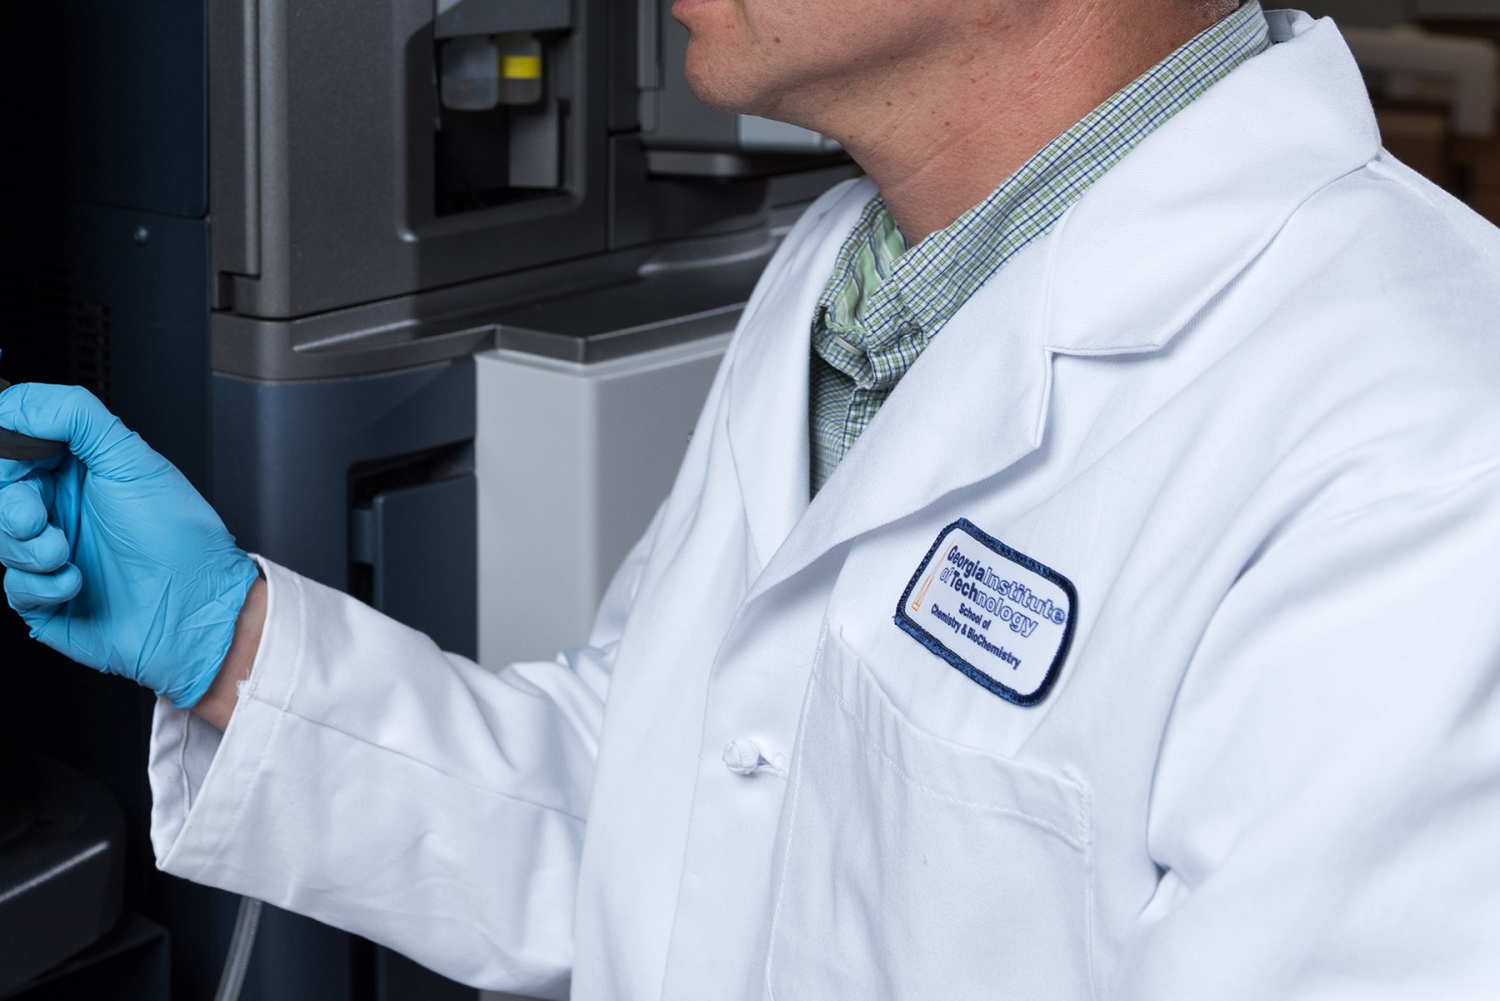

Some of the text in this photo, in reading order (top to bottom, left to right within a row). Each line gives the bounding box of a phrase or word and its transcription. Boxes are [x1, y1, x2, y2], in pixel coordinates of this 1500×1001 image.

[930, 603, 1023, 671] Chemistry & BioChemistry
[958, 602, 993, 632] School of
